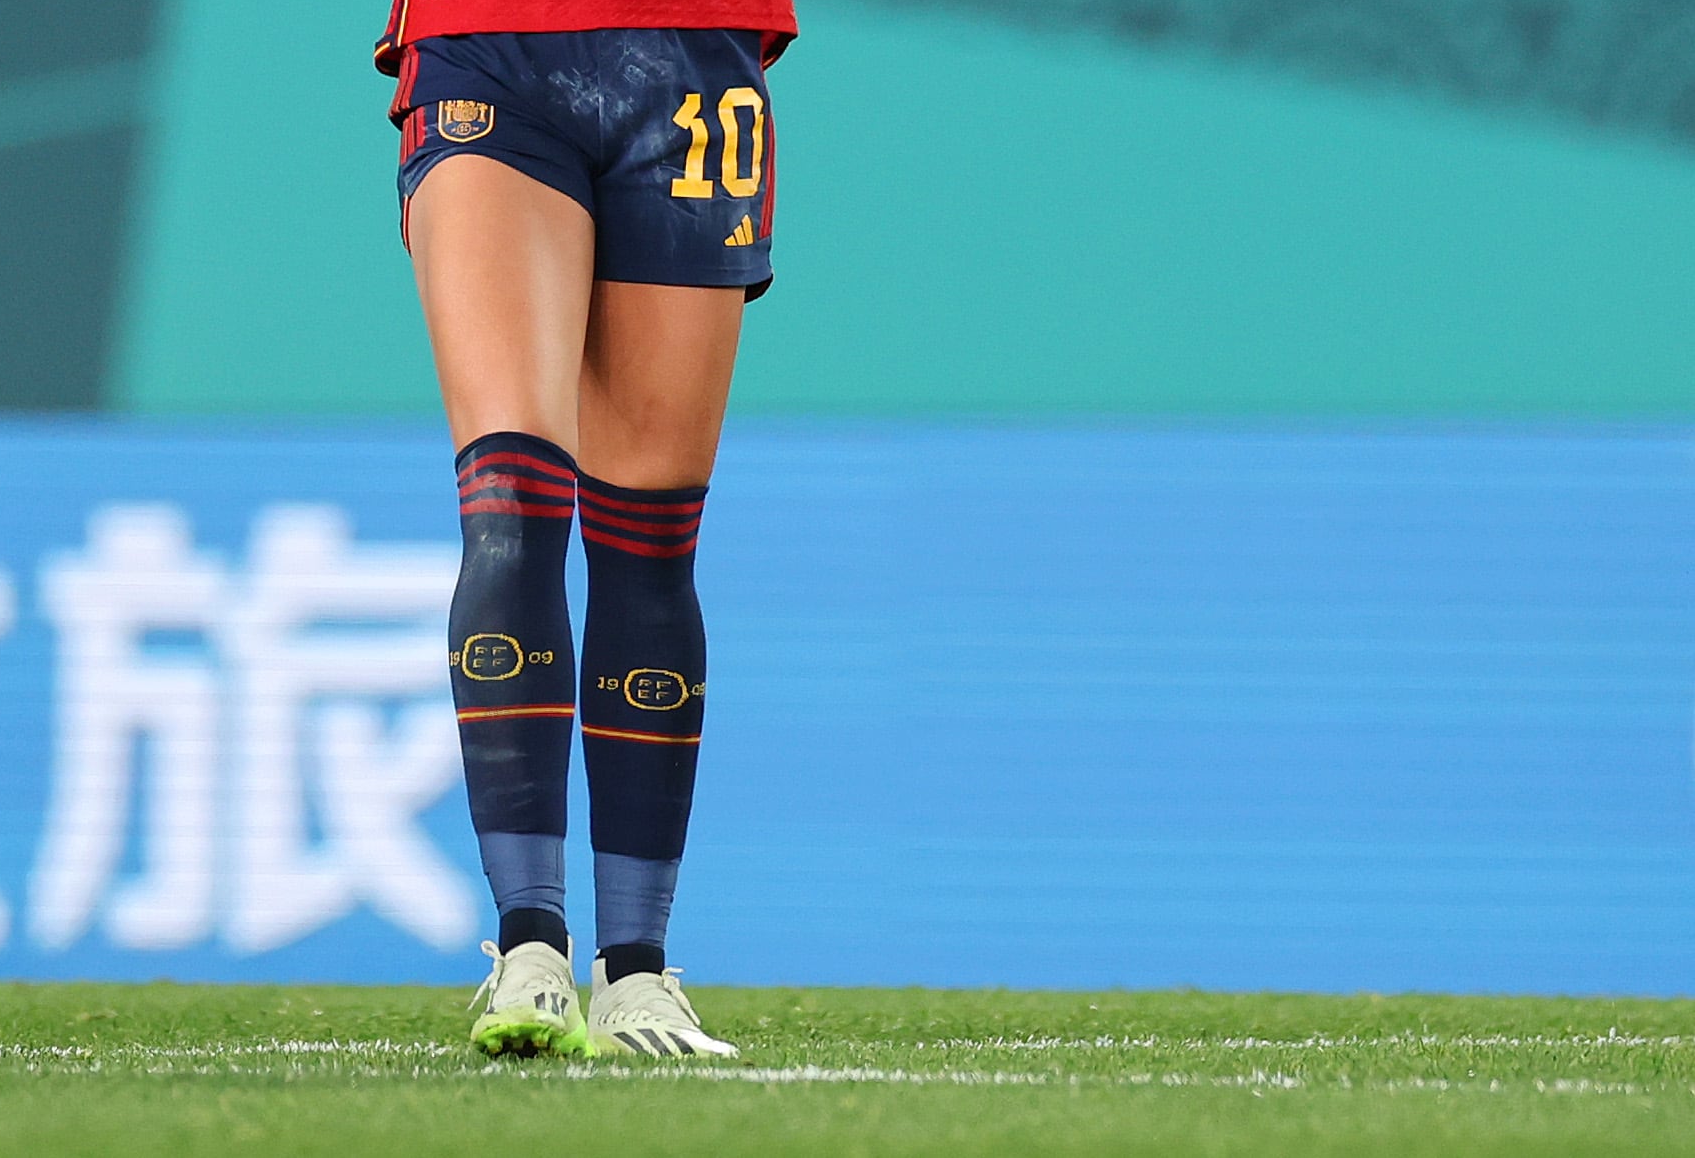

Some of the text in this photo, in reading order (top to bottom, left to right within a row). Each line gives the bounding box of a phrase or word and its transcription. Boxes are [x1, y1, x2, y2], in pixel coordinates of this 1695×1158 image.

[671, 87, 764, 198] 10
[528, 650, 554, 665] 09
[596, 676, 620, 691] 19
